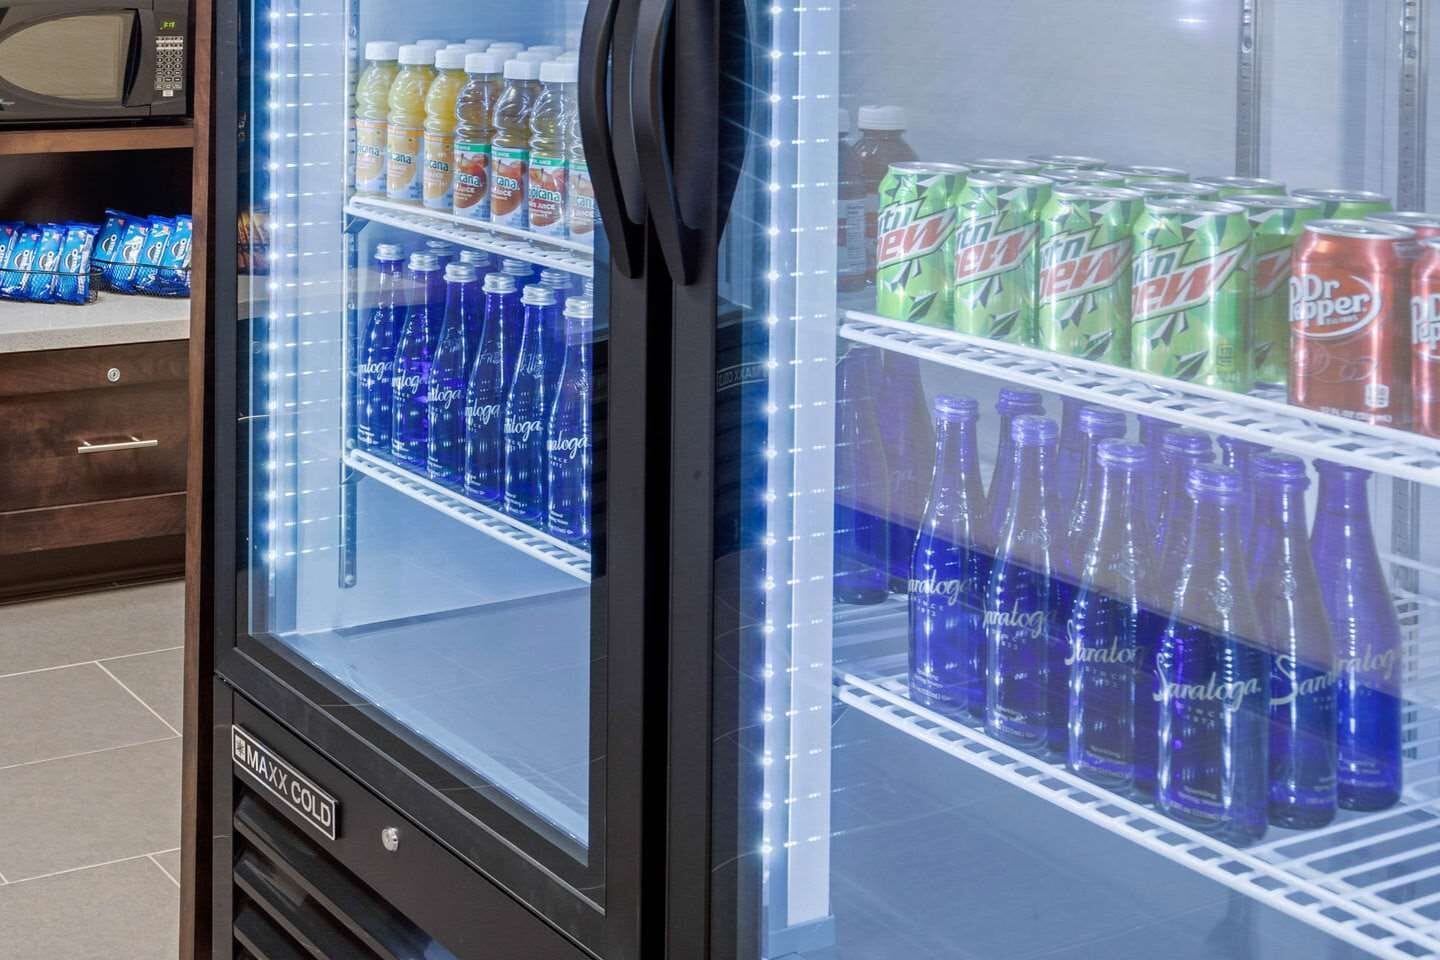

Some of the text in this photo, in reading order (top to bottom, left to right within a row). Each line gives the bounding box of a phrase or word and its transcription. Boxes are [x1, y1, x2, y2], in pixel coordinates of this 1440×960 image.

[878, 207, 912, 235] tn
[878, 211, 954, 263] ew
[956, 221, 993, 249] tn
[955, 224, 1039, 279] ew
[1041, 236, 1086, 264] tn
[1133, 250, 1177, 283] tn
[1040, 241, 1129, 298] ew
[1132, 255, 1234, 316] ew
[1302, 274, 1341, 302] Dr
[359, 358, 393, 377] atoga
[392, 370, 427, 394] atoga
[428, 383, 462, 409] atoga
[464, 397, 501, 424] atoga
[503, 413, 544, 441] atoga
[547, 430, 590, 459] atoga
[908, 569, 971, 606] aratoga
[1064, 619, 1144, 670] Saratog
[1332, 643, 1394, 681] ratog
[1152, 653, 1262, 712] Saratoga
[1270, 654, 1335, 705] Sara
[247, 747, 332, 827] MAXX COLD
